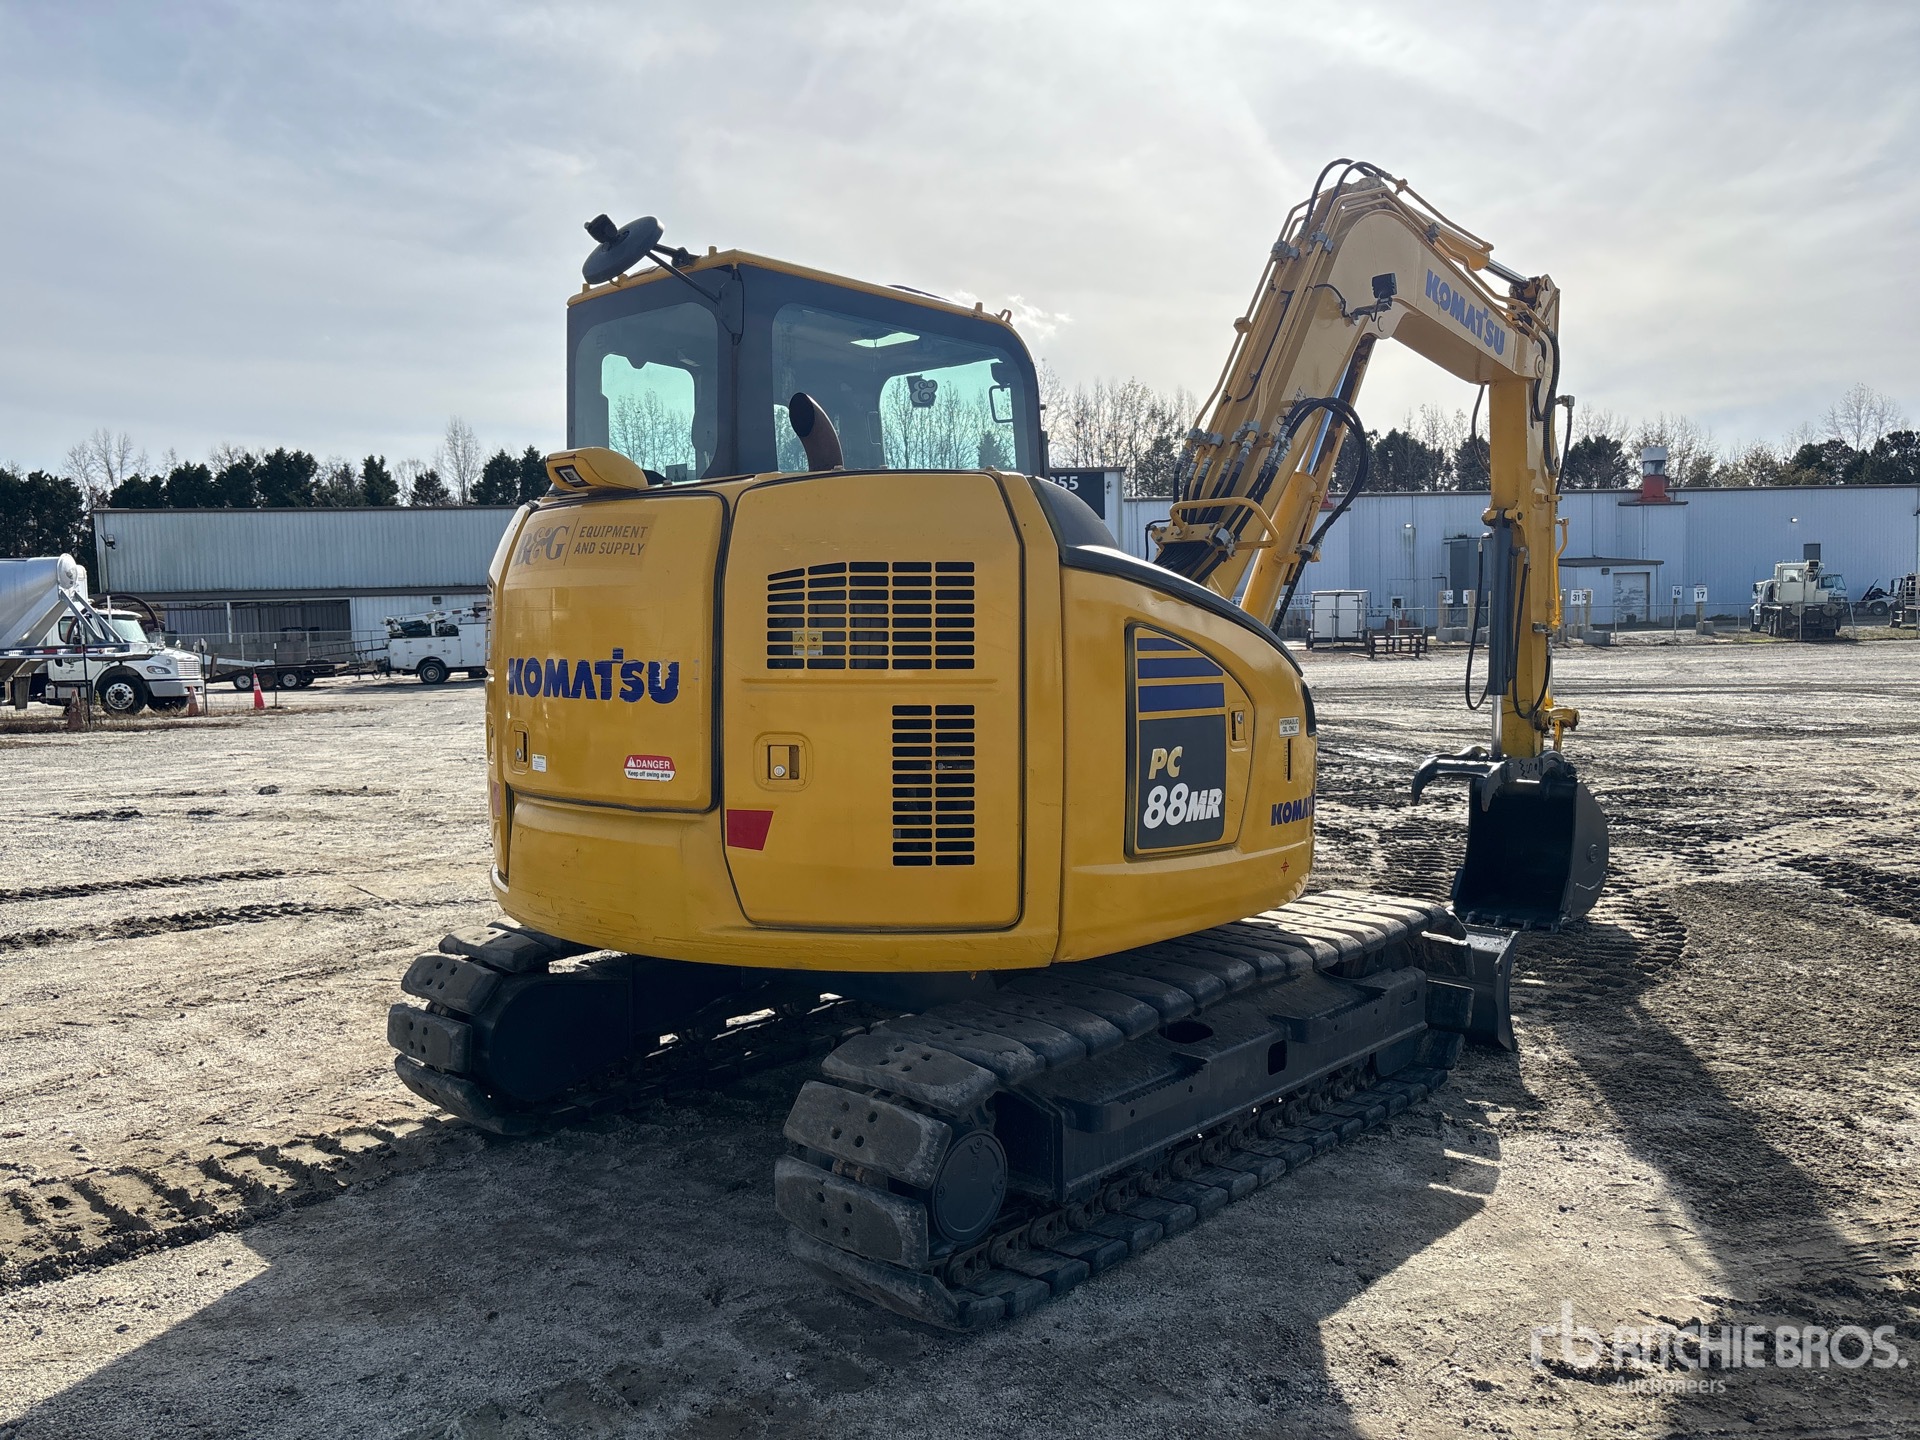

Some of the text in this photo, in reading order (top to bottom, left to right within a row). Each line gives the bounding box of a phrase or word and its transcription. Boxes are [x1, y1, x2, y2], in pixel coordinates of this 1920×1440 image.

[1425, 269, 1505, 355] KOMATSU
[574, 542, 646, 556] AND SUPPLY
[579, 526, 648, 538] EQUIPMENT
[1696, 591, 1705, 599] 17
[508, 648, 680, 704] KOMATSU
[636, 759, 671, 770] DANGER
[1148, 746, 1183, 780] PC
[1143, 783, 1223, 829] 88MR
[1271, 790, 1314, 826] KOMAT
